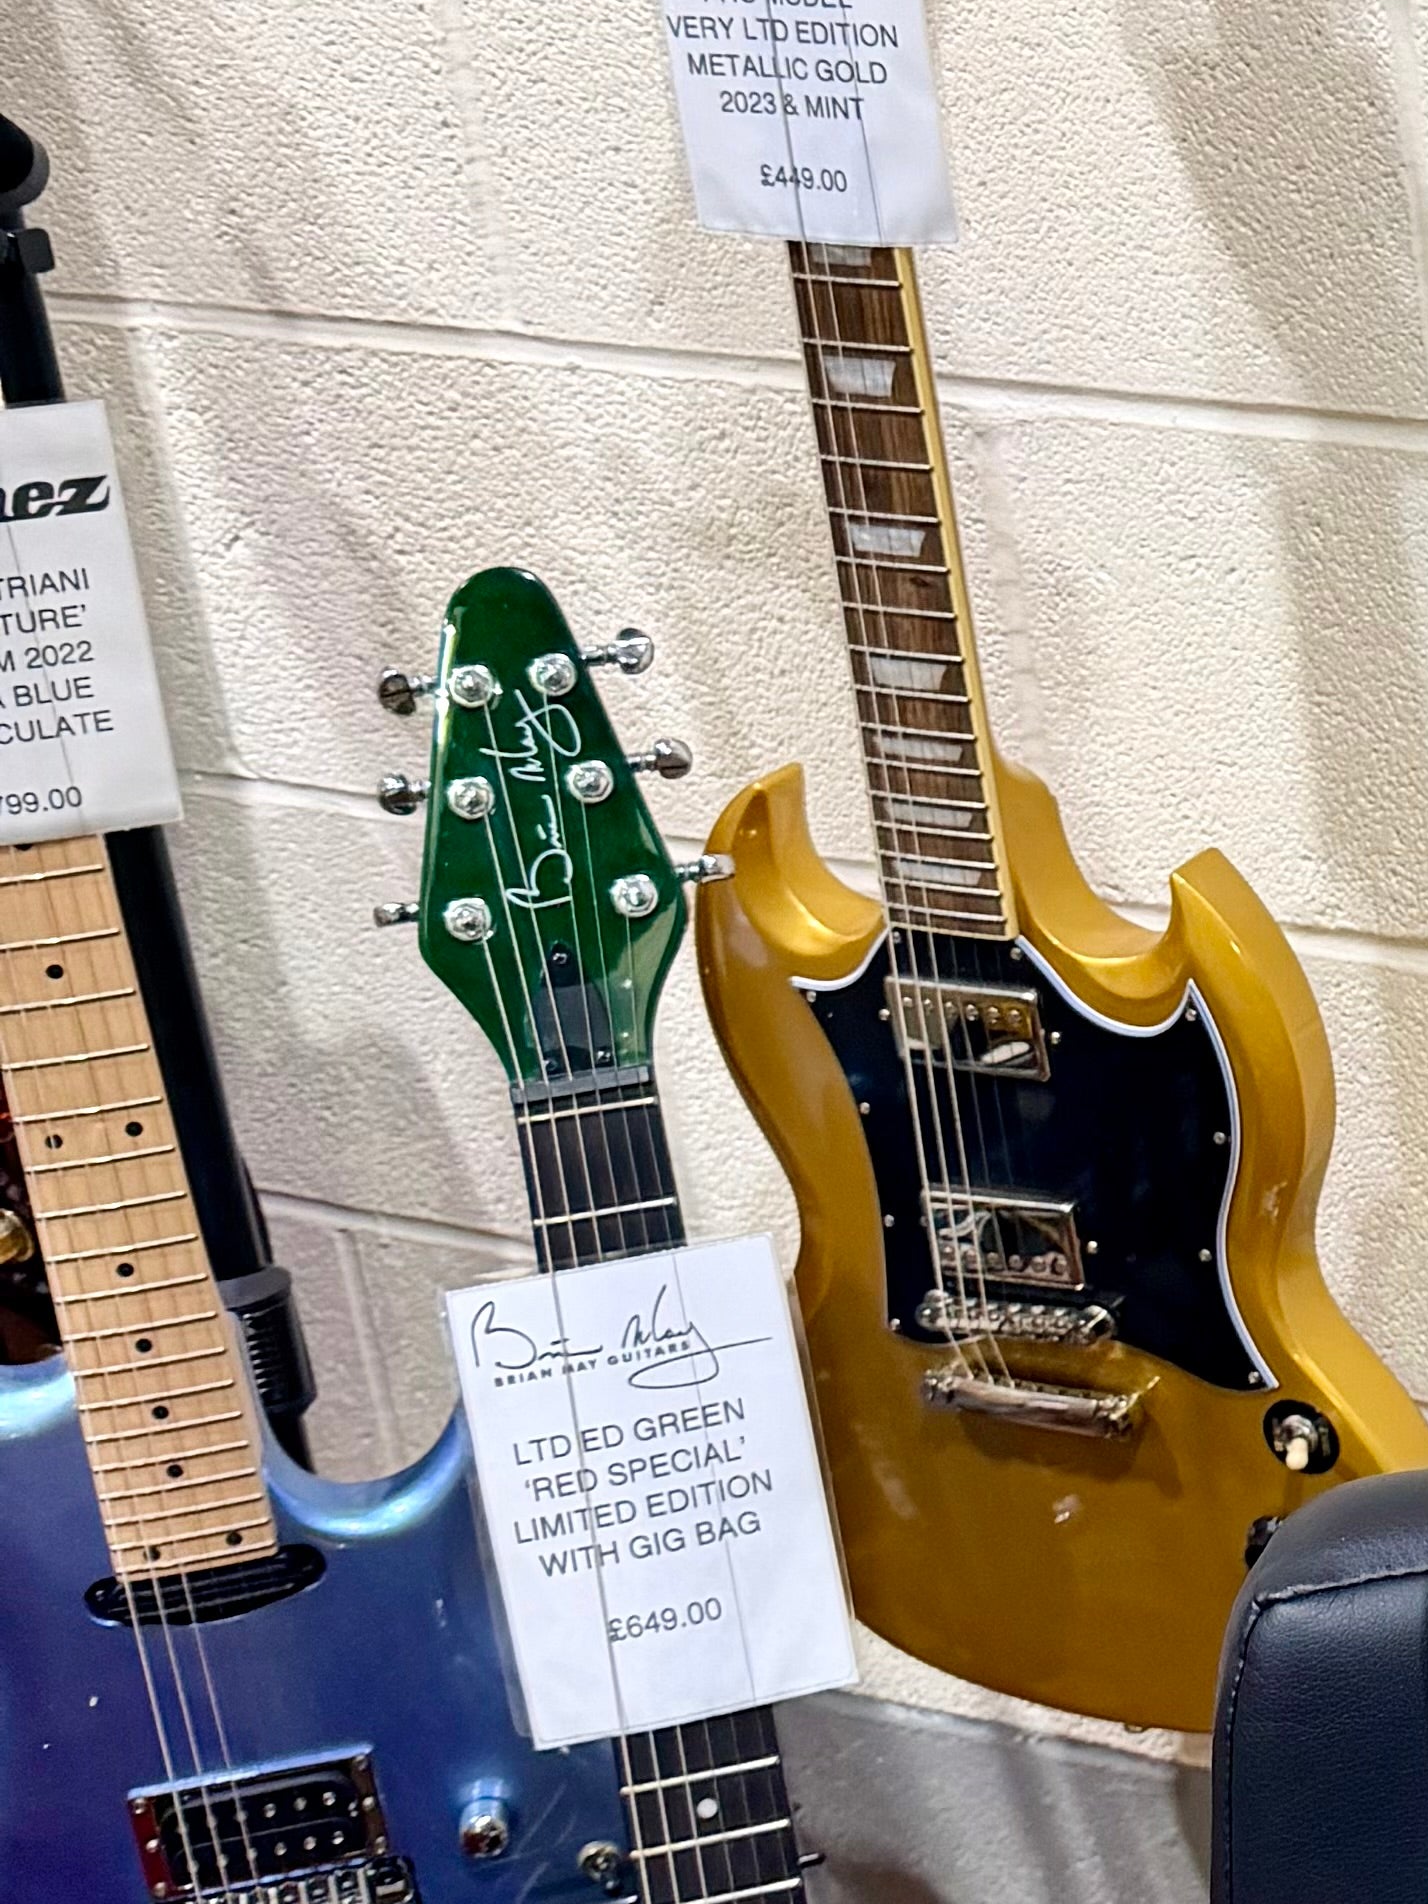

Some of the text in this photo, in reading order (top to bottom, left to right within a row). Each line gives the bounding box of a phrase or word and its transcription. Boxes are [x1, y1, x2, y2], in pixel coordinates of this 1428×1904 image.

[667, 16, 899, 48] VERY LTD EDITION
[688, 53, 887, 84] METALLIC GOLD
[721, 91, 864, 120] 2023 & MINT
[761, 164, 847, 192] £449.00
[24, 640, 95, 669] 2022
[13, 676, 95, 707] BLUE
[0, 786, 83, 816] 99.00
[494, 1340, 691, 1388] BRIAN MAY GUITARS
[513, 1398, 745, 1466] LTD ED GREEN
[525, 1436, 746, 1502] 'RED SPECIAL'
[514, 1469, 773, 1544] LIMITED EDITION
[539, 1511, 761, 1577] WITH GIG BAG
[608, 1597, 722, 1643] £649.00
